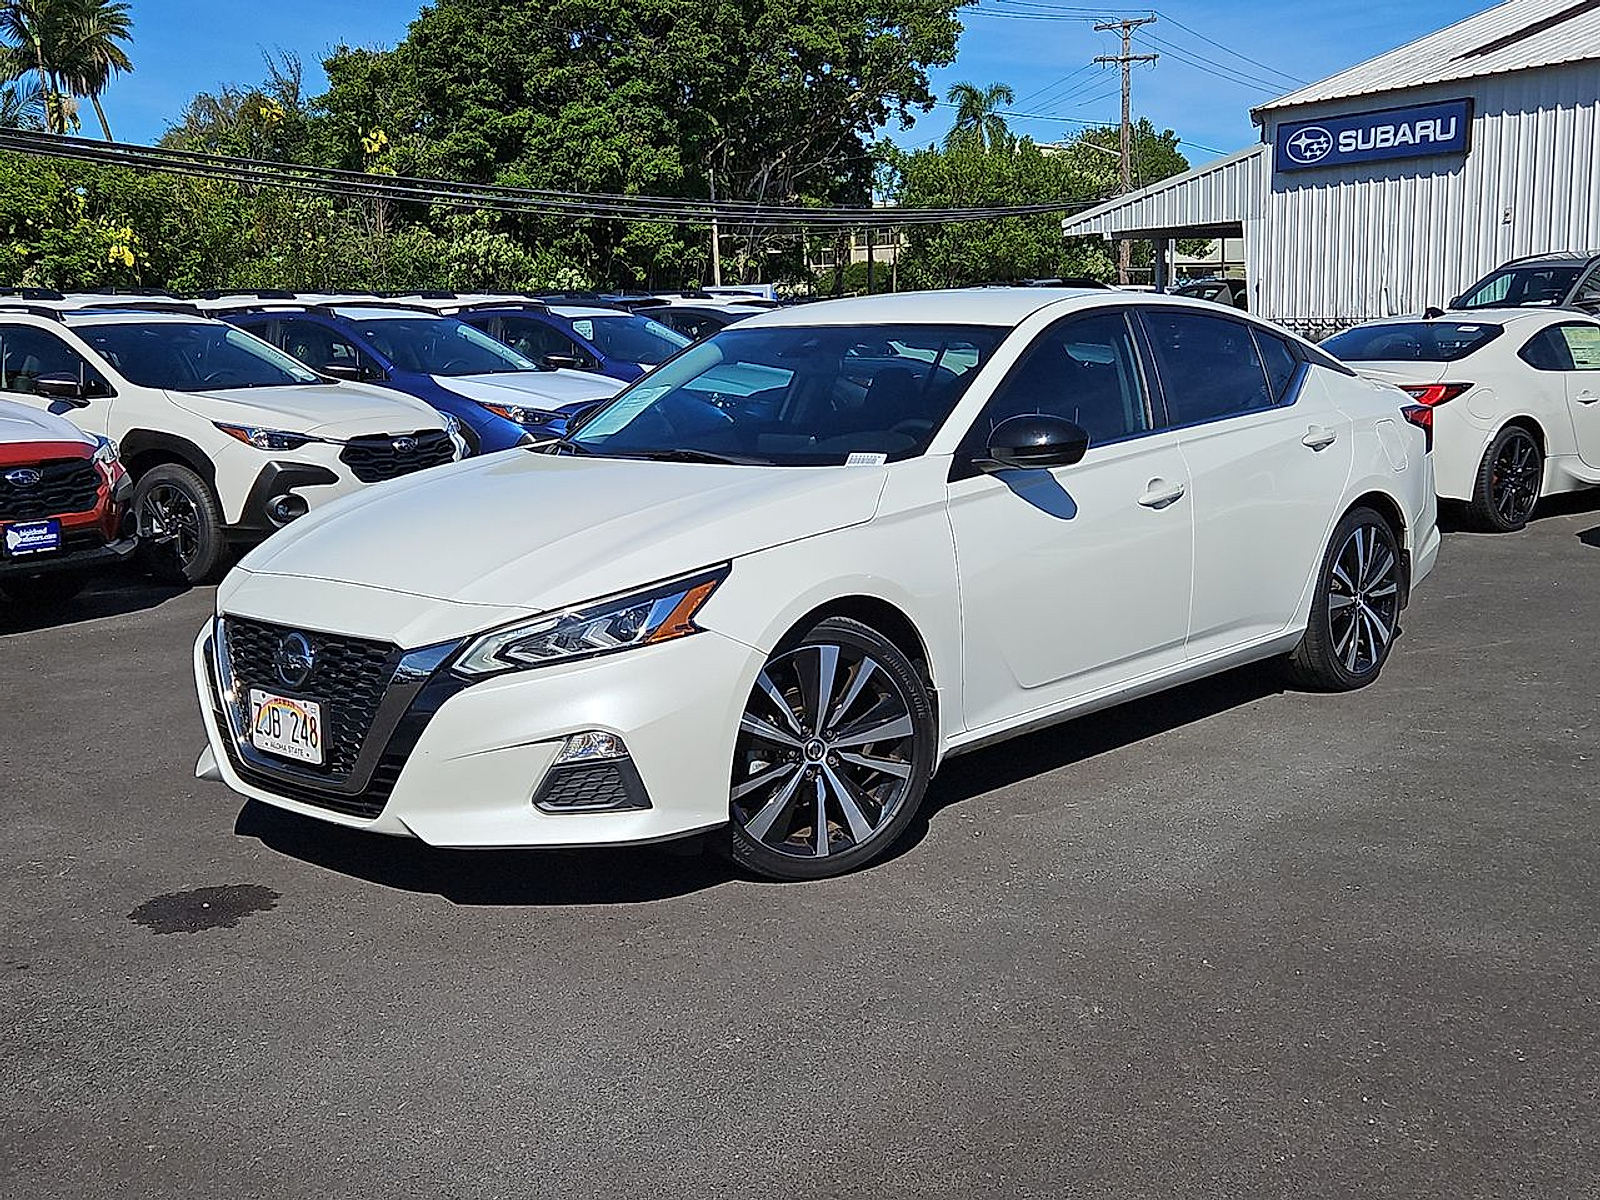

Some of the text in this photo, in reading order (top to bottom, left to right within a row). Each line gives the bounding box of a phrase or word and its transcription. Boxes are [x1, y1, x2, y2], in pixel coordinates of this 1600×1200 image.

[1338, 116, 1456, 153] SUBARU
[253, 701, 318, 749] ZJB 248
[287, 745, 304, 757] STATE
